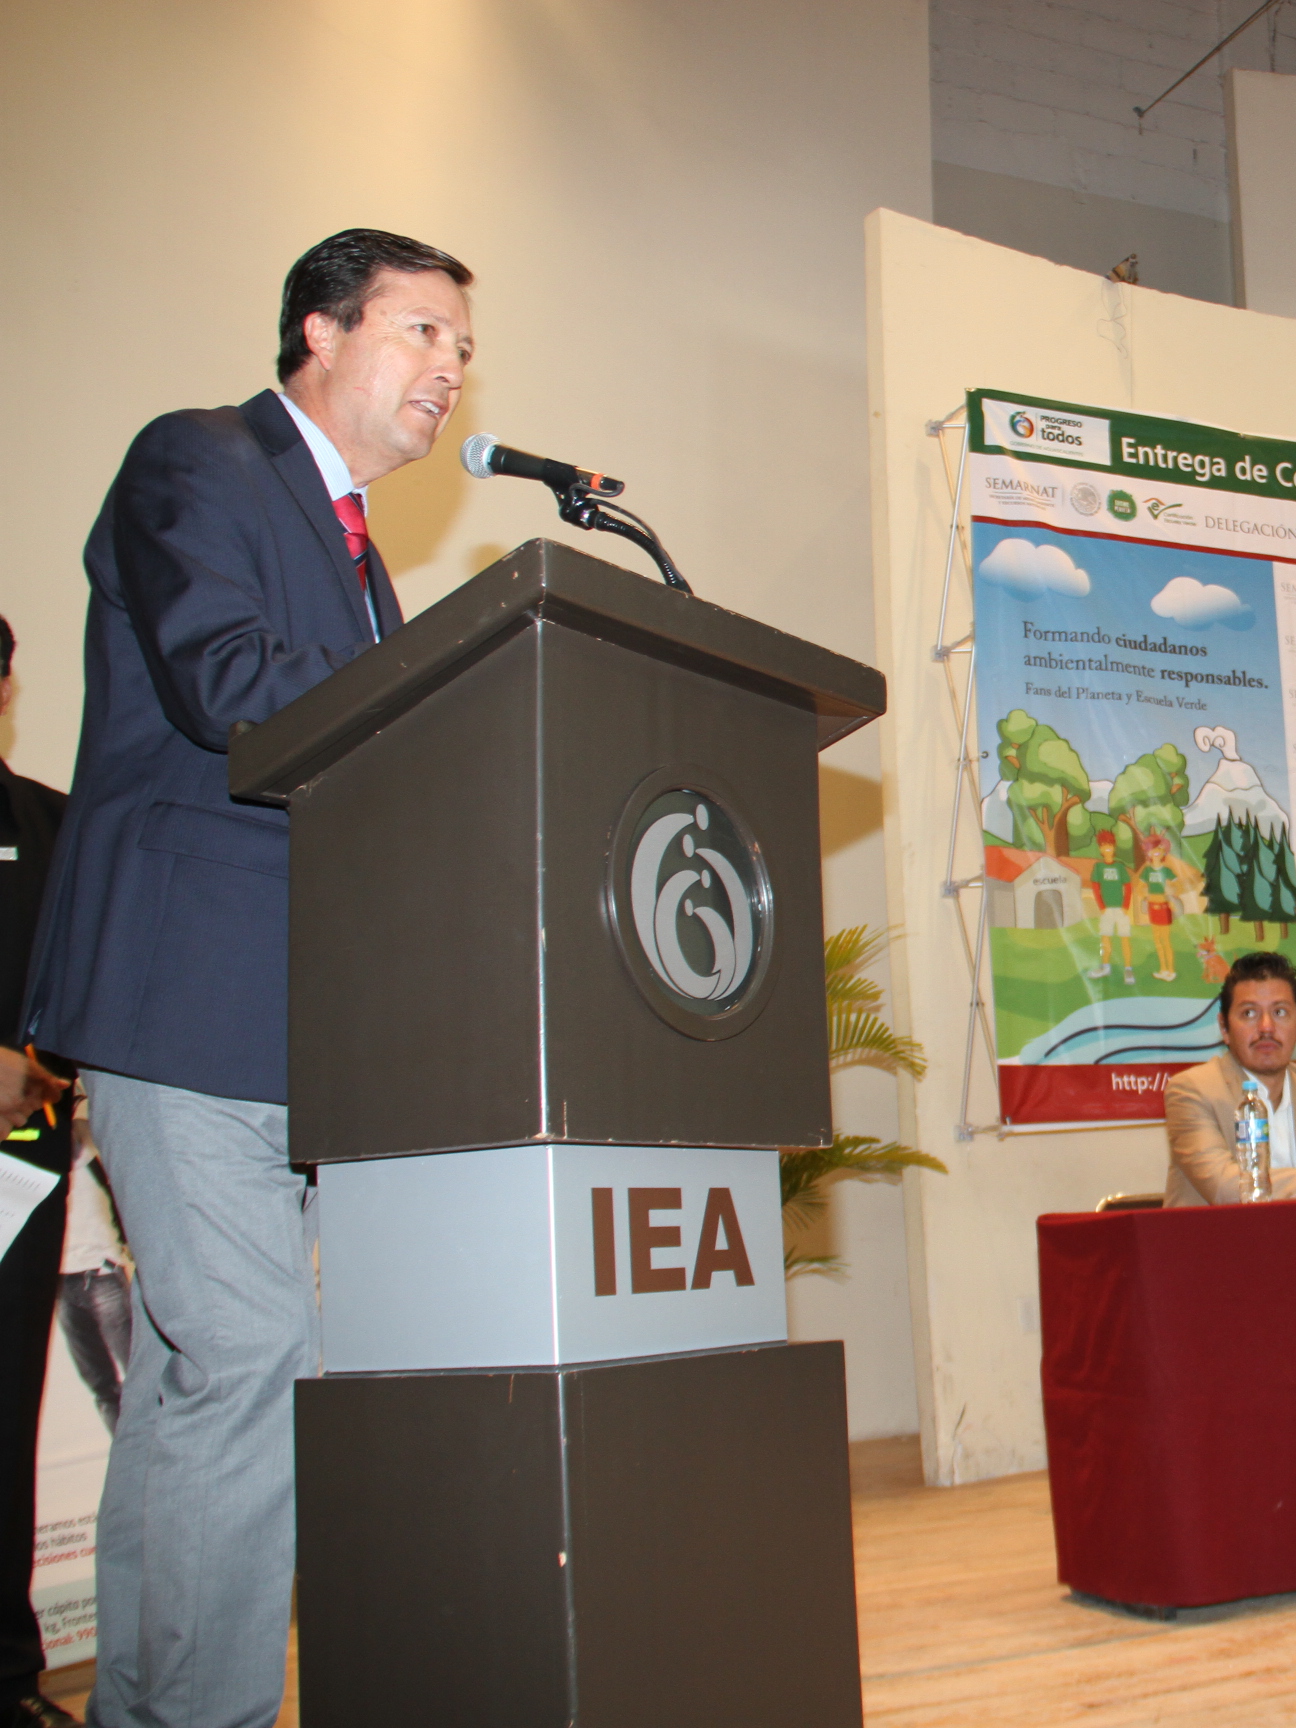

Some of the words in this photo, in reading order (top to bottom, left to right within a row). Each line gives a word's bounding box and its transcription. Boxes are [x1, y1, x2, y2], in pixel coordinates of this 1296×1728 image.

[1040, 415, 1082, 428] PROGRESO
[1041, 428, 1083, 446] todos
[1121, 437, 1228, 481] Entrega
[1235, 455, 1268, 483] de
[985, 477, 1058, 498] SEMARNAT
[1022, 621, 1111, 645] Formando
[1115, 633, 1208, 657] ciudadanos
[1024, 652, 1155, 679] ambientalmente
[1160, 668, 1269, 689] responsables.
[1025, 682, 1052, 697] Fans
[1055, 685, 1071, 699] del
[1076, 687, 1122, 701] Planeta
[1126, 692, 1133, 705] y
[1136, 690, 1173, 708] Escuela
[1176, 697, 1208, 711] Verde
[1111, 1072, 1170, 1094] http://
[591, 1187, 755, 1296] IEA
